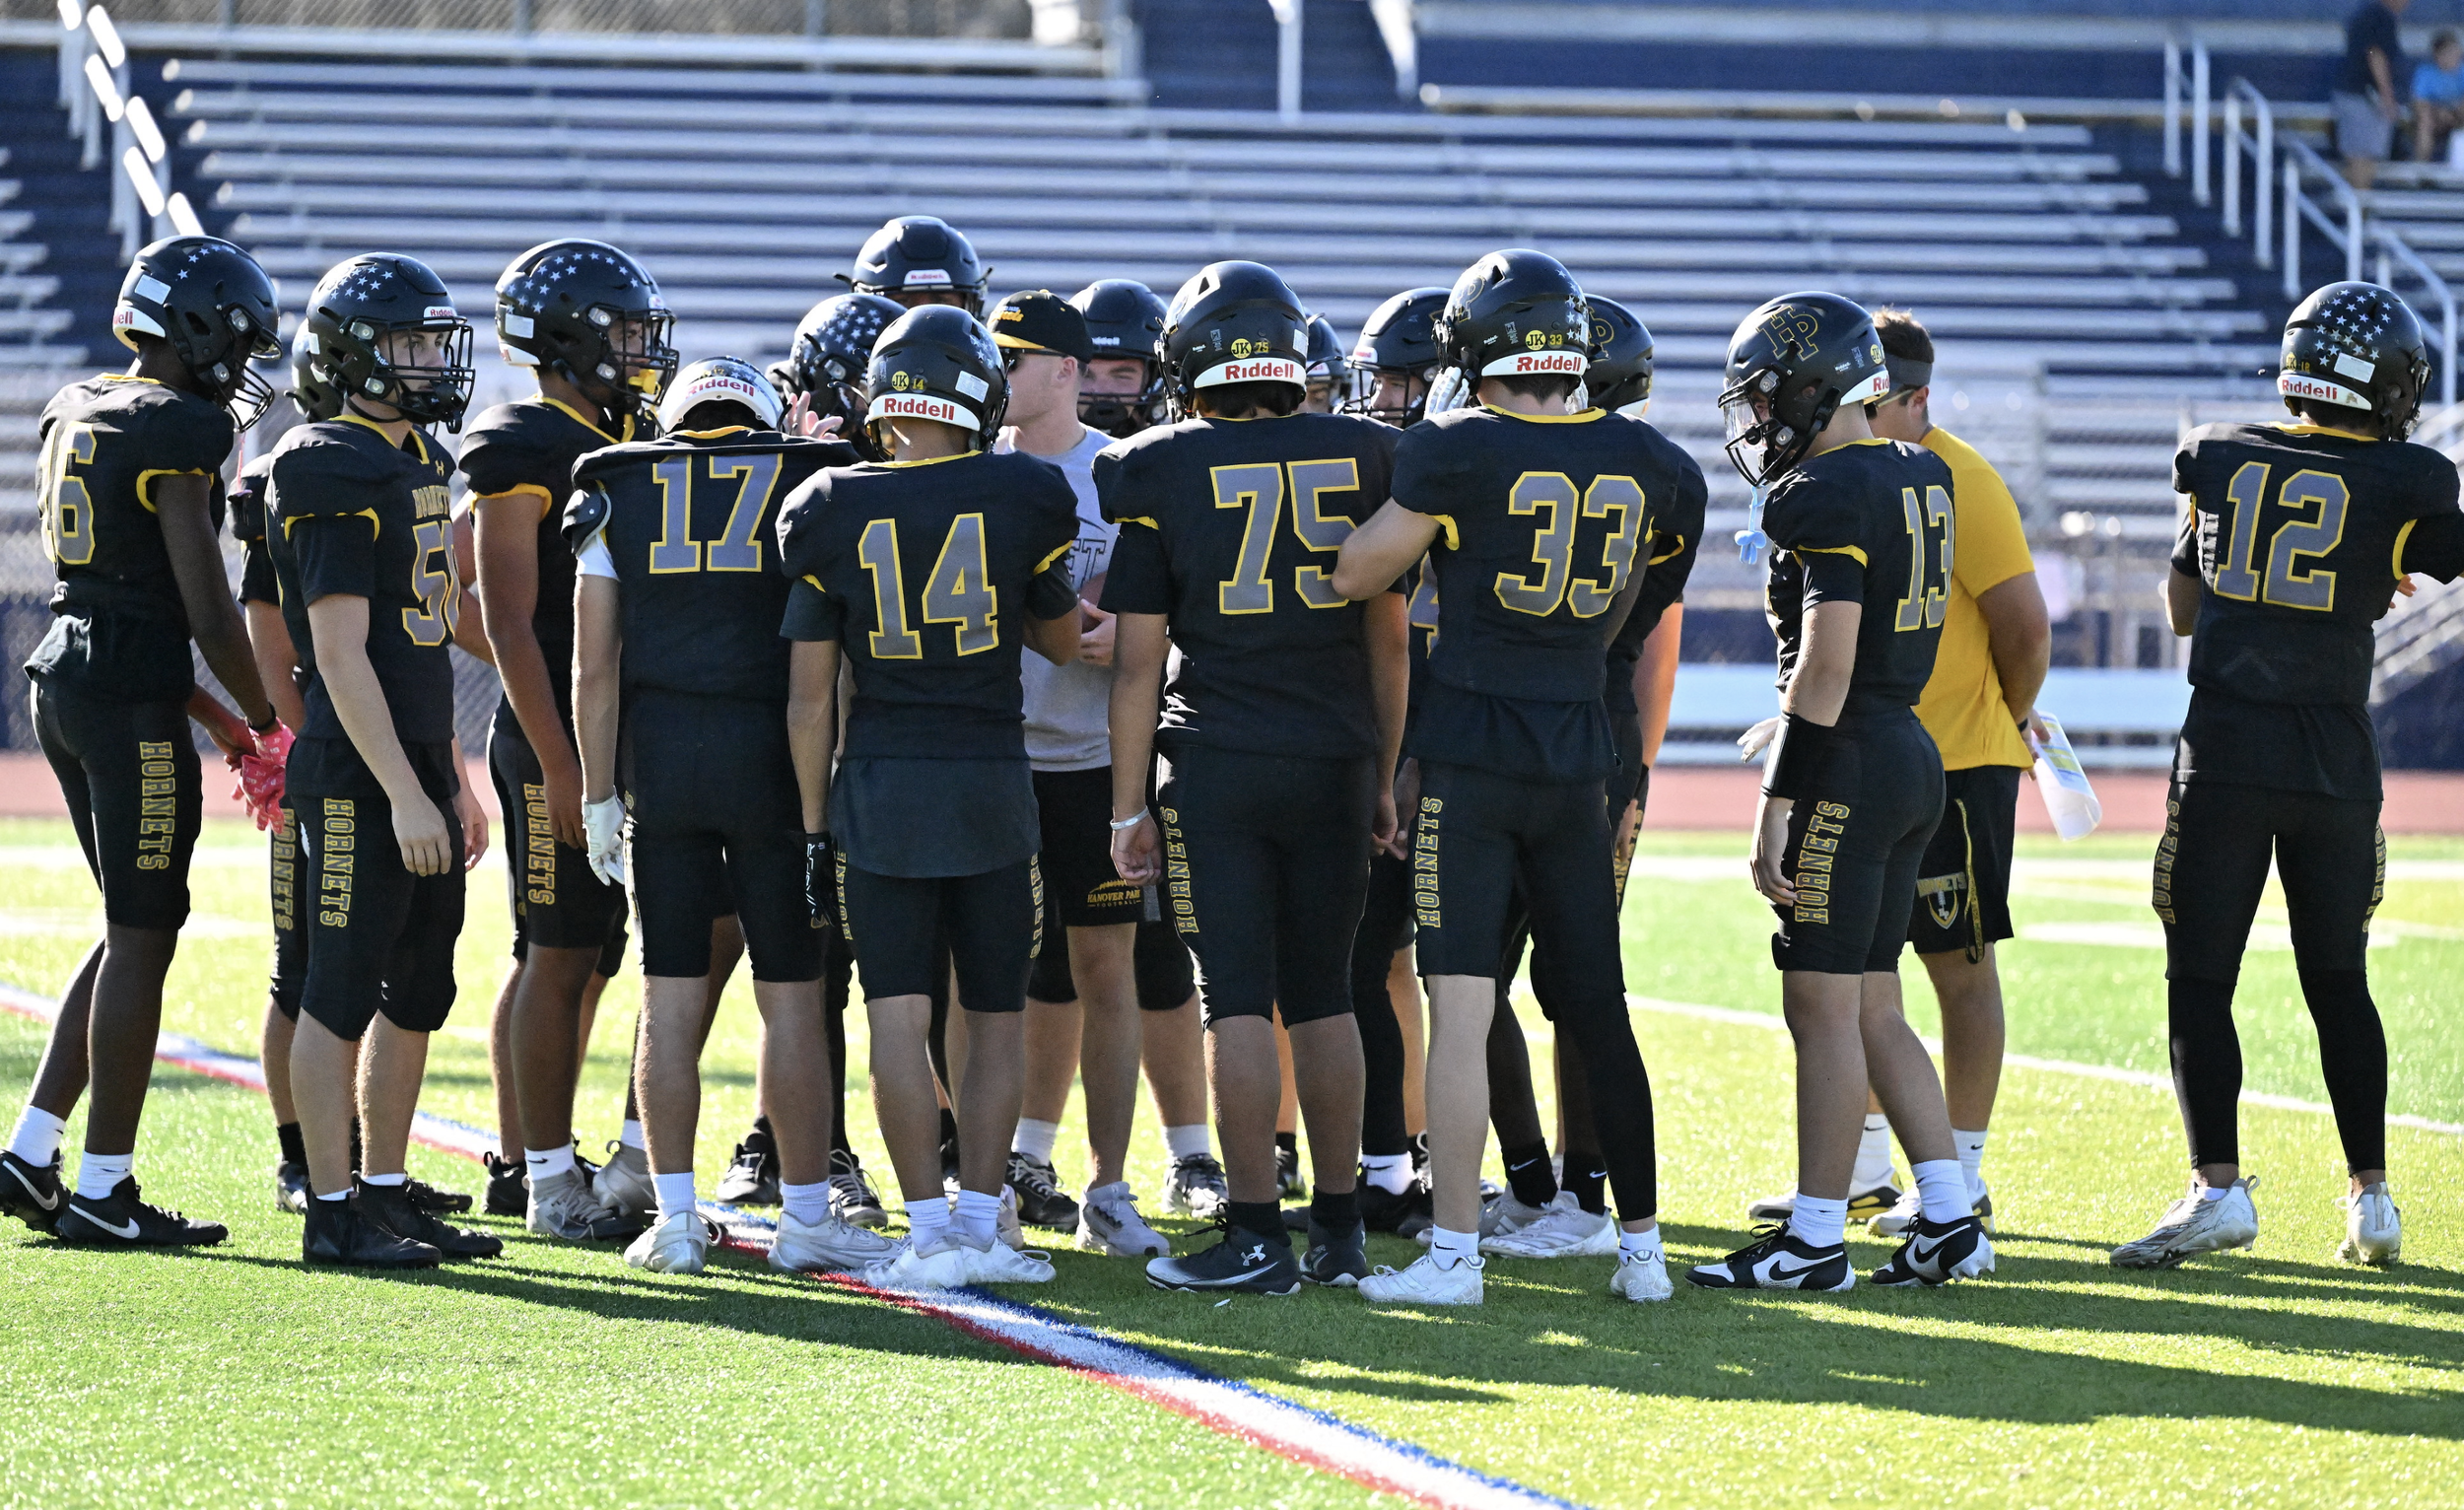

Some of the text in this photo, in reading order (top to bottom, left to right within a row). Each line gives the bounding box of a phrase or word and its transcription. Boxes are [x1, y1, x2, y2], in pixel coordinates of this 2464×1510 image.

[892, 375, 908, 387] JK
[913, 378, 924, 390] 14
[1225, 362, 1294, 380] Riddell
[1233, 342, 1250, 355] JK
[1517, 356, 1582, 373] Riddell
[1527, 333, 1543, 346] JK
[1549, 334, 1562, 345] 33
[2283, 379, 2338, 400] Riddell
[884, 398, 955, 421] Riddell
[650, 452, 784, 574] 17
[1209, 457, 1360, 615] 75
[1493, 471, 1645, 618] 33
[1894, 484, 1954, 633] 13
[2214, 460, 2351, 612] 12
[857, 513, 999, 659] 14
[137, 741, 176, 869] HORNETS
[320, 798, 355, 928] HORNETS
[1414, 796, 1444, 928] HORNETS
[1795, 800, 1851, 925] HORNETS
[1087, 891, 1125, 903] HANOVER
[1160, 806, 1199, 933] HORNETS
